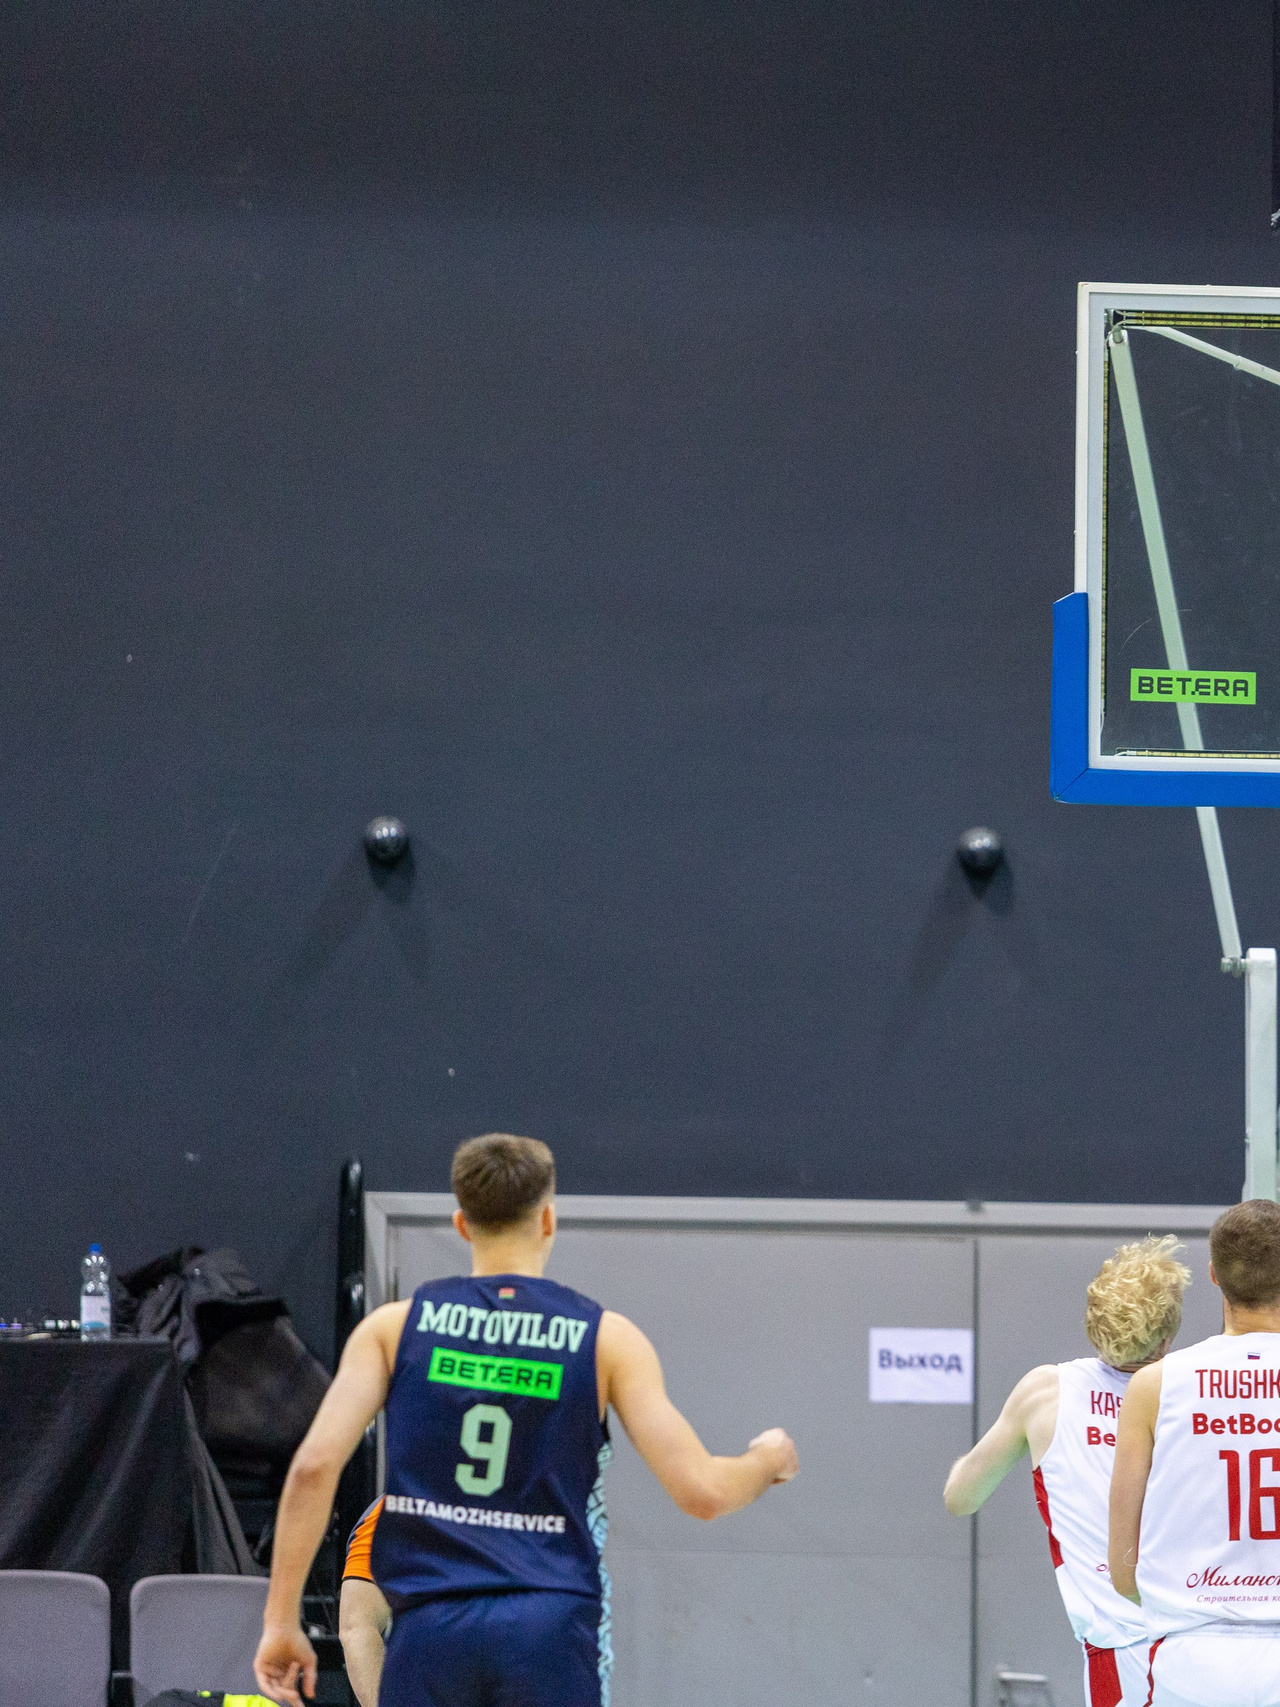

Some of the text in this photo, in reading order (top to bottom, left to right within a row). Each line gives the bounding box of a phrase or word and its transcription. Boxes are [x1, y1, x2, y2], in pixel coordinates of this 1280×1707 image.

[417, 1300, 588, 1354] MOTOVILOV
[878, 1348, 963, 1374] Выход
[455, 1403, 513, 1497] 9
[385, 1495, 566, 1534] BELTAMOZHSERVICE
[1196, 1594, 1269, 1604] Строительная
